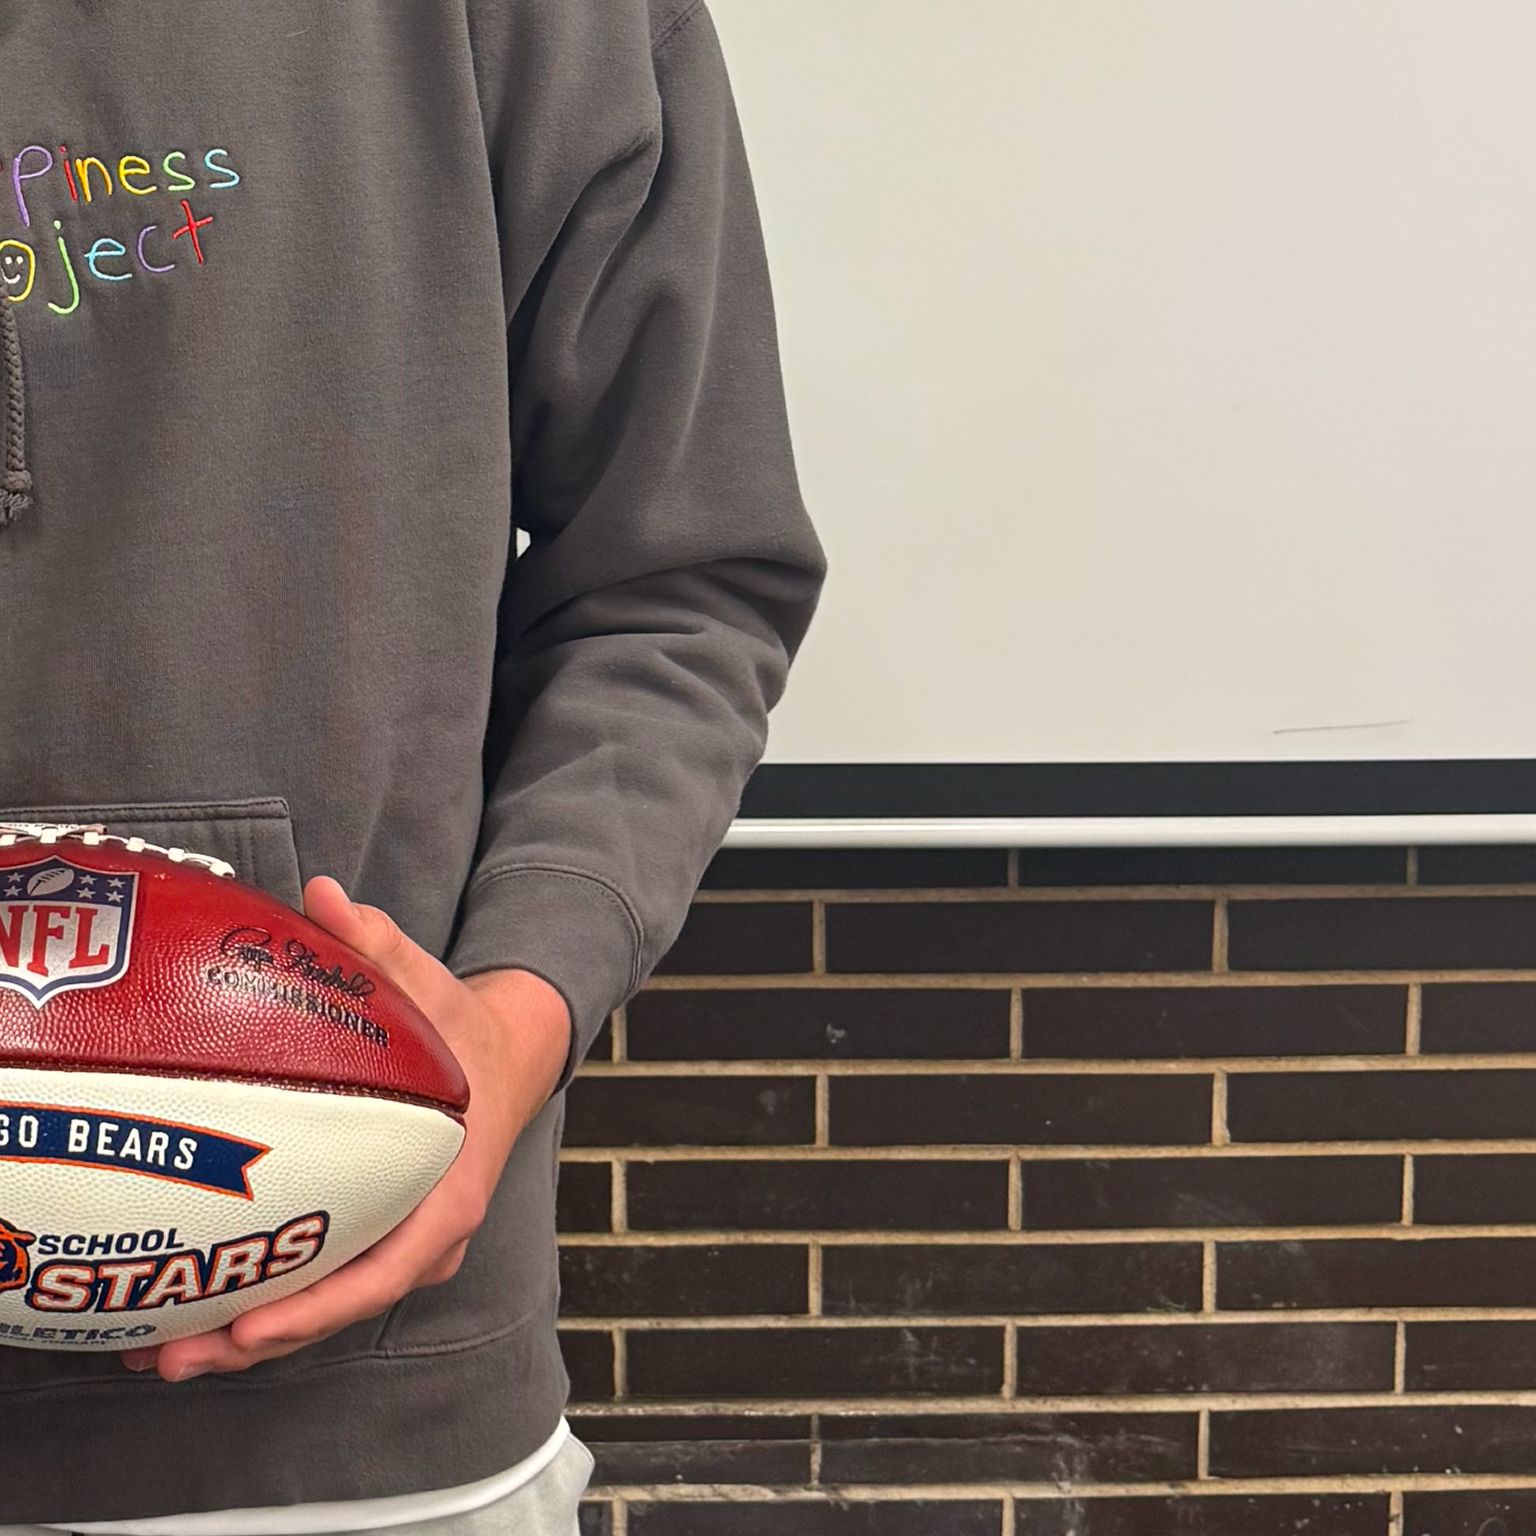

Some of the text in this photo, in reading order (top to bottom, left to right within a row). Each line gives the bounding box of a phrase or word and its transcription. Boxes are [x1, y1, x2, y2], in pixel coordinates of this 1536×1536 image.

[207, 966, 389, 1048] COMMISSIONER
[67, 1118, 198, 1170] BEARS
[25, 1210, 330, 1313] STARS
[38, 1228, 185, 1256] SCHOOL
